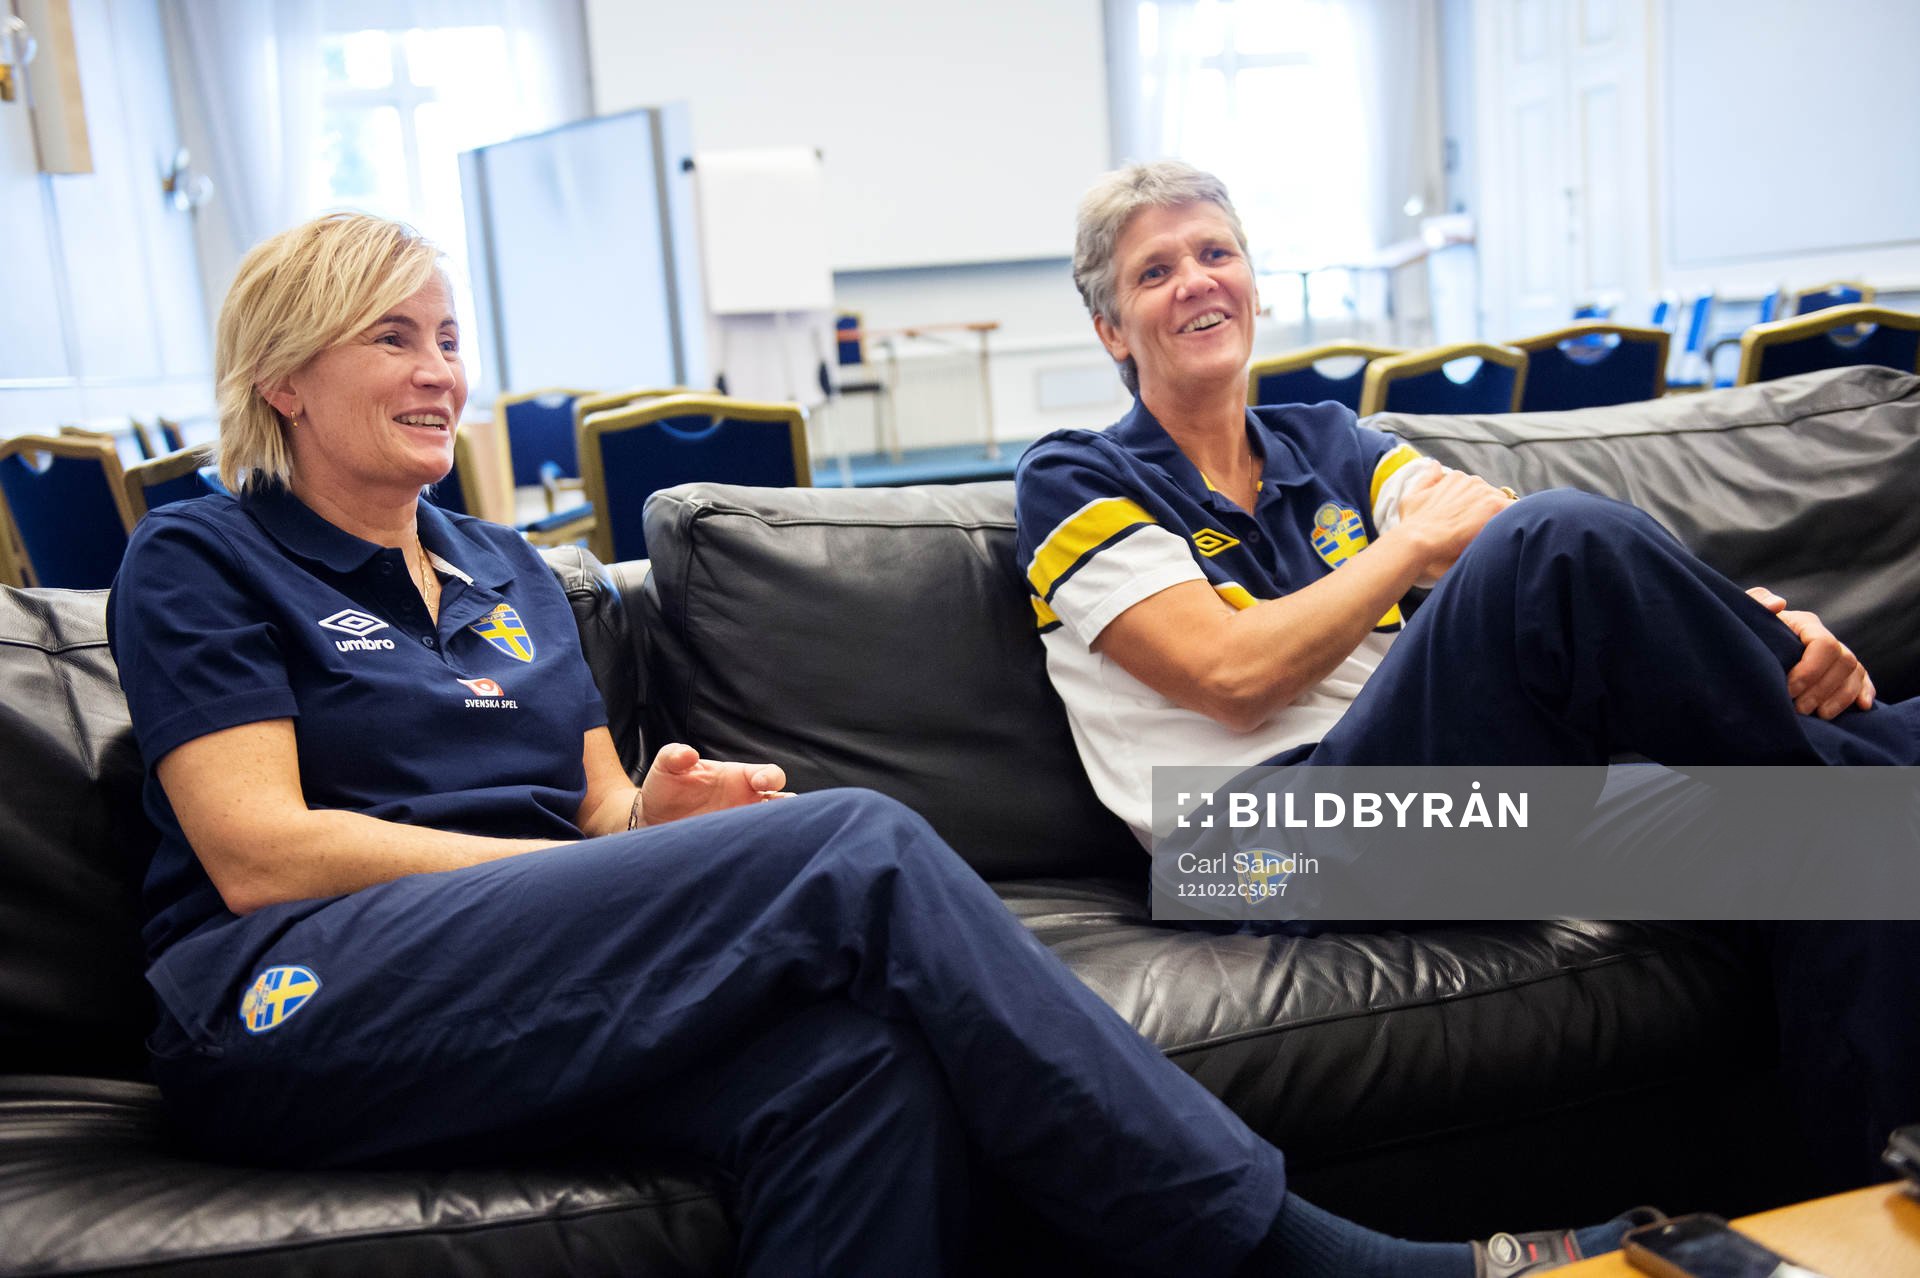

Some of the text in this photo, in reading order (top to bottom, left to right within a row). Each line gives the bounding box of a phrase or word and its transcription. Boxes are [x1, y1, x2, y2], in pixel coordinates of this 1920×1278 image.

[335, 637, 395, 652] umbro
[464, 698, 518, 709] SVENSKA SPEL
